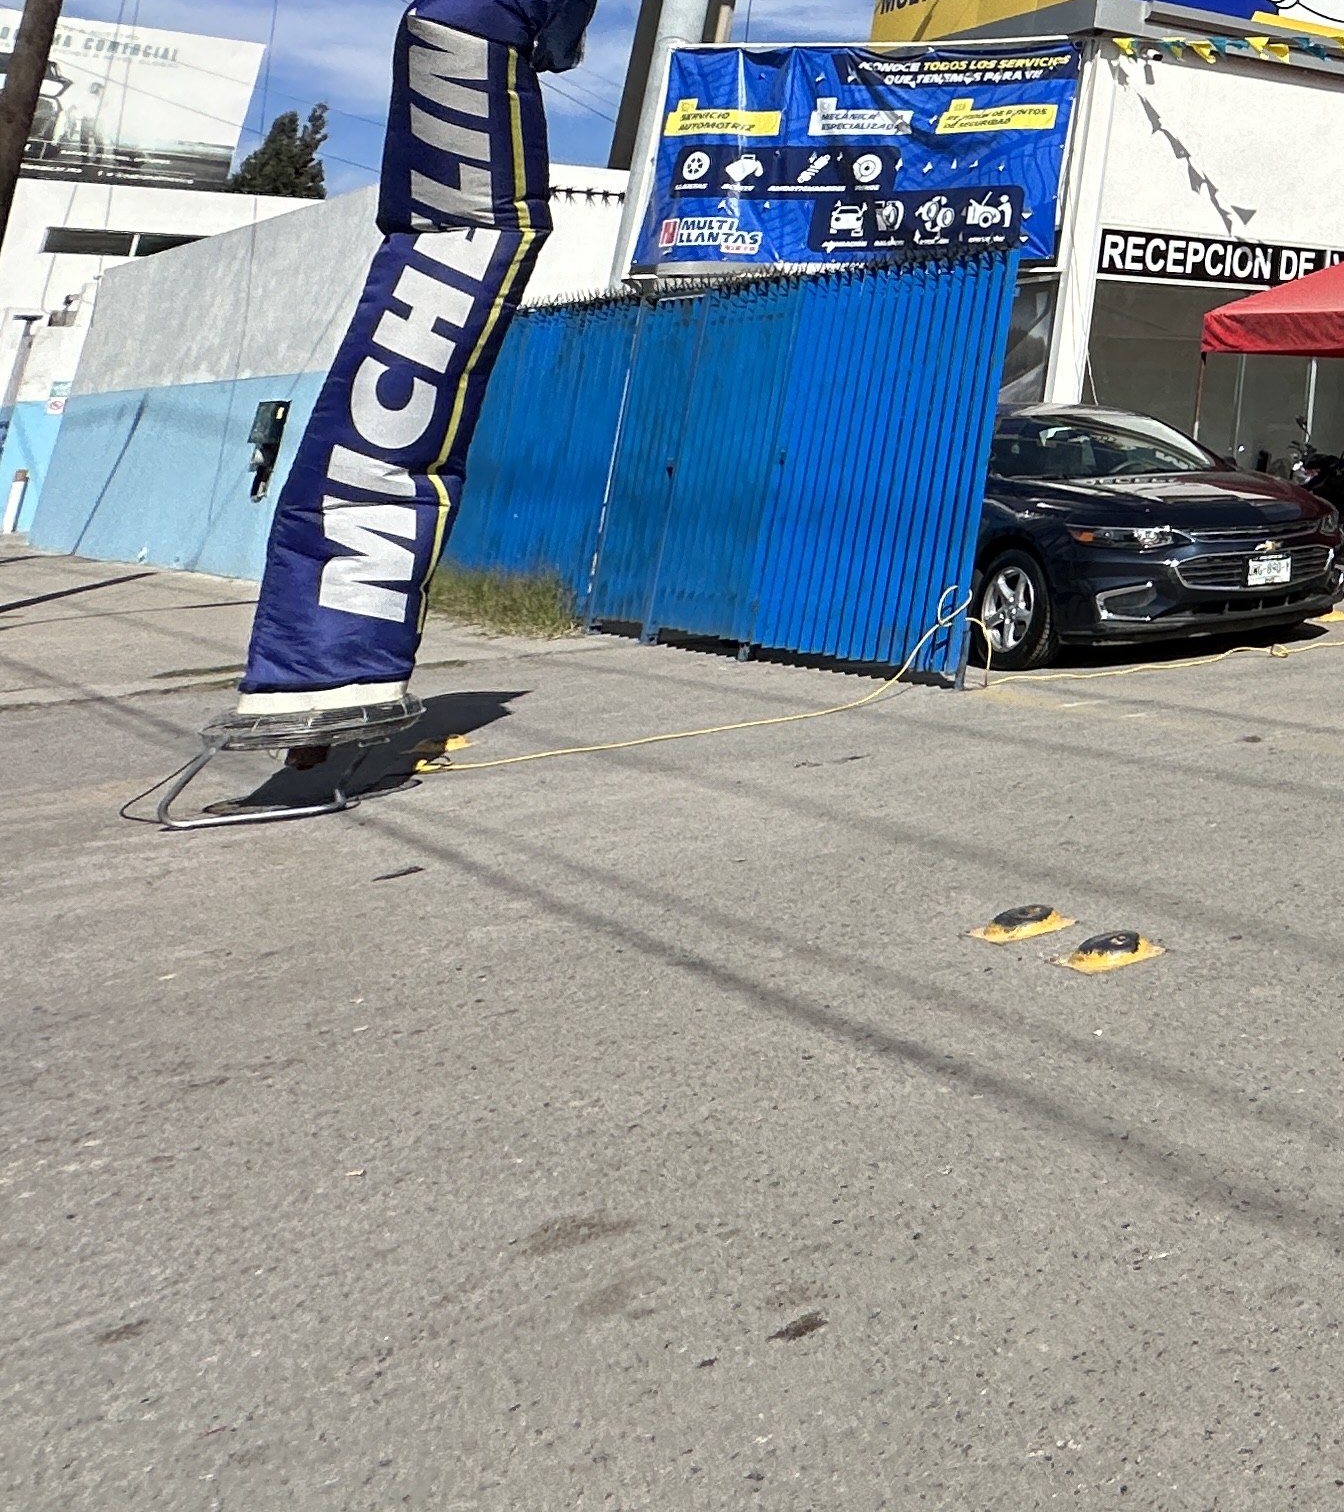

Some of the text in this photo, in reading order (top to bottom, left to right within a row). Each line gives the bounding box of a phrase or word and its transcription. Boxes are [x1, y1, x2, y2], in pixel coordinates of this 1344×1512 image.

[923, 59, 967, 71] TODOS
[969, 58, 998, 70] LOS
[997, 54, 1072, 70] SERVICIOS
[681, 219, 736, 231] MULTI
[679, 231, 760, 245] LLANTAS
[1101, 234, 1316, 281] RECEPCION DE
